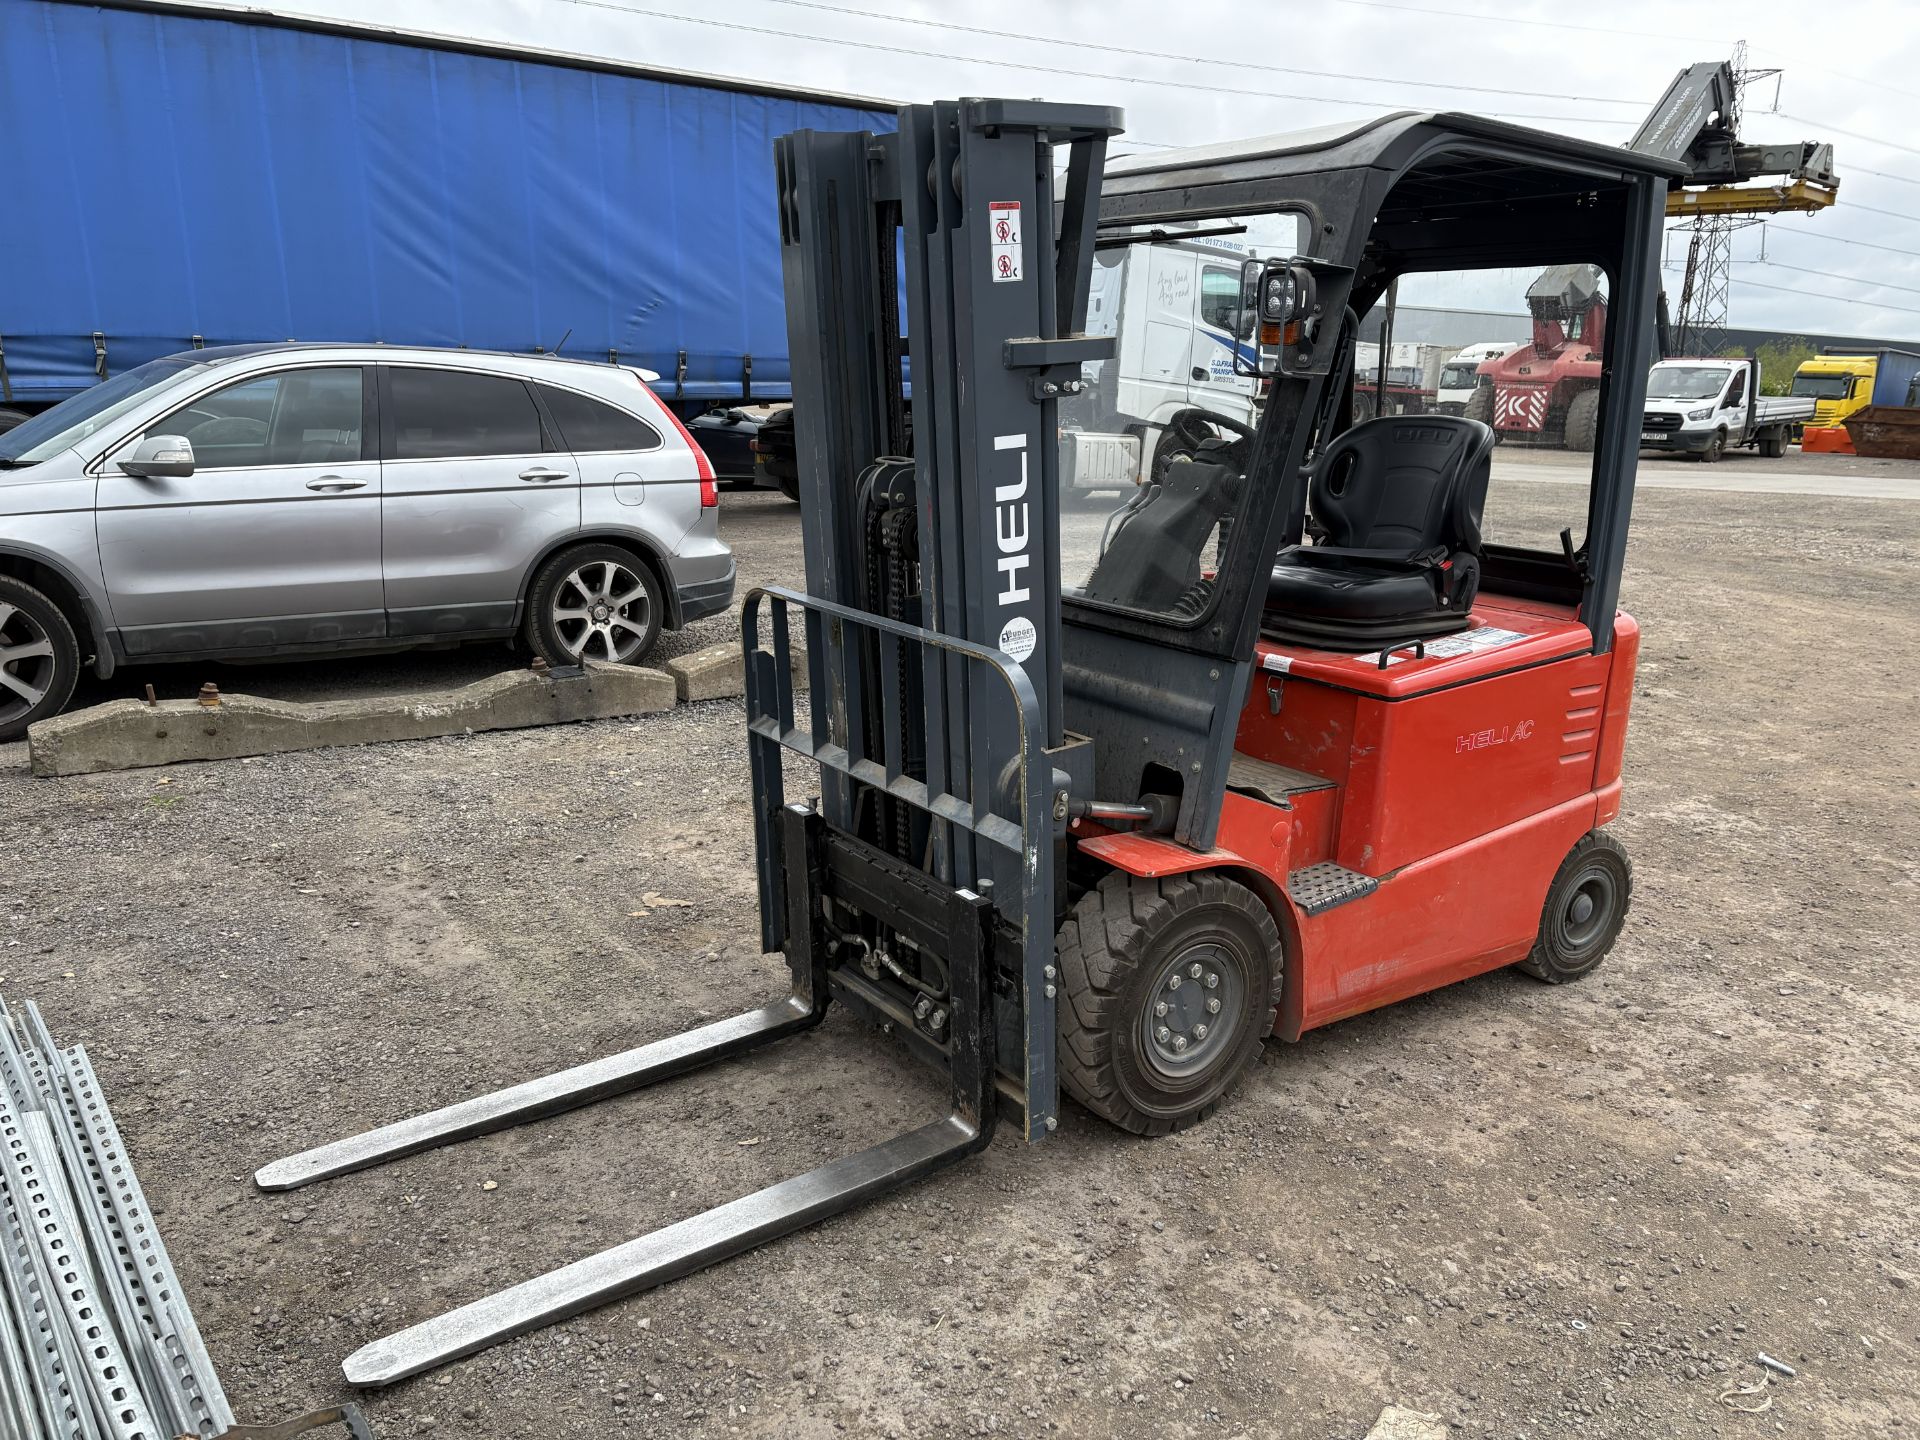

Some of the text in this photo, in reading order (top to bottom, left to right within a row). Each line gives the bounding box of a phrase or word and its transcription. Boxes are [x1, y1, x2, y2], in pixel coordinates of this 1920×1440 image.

[1158, 270, 1172, 290] Any
[1159, 286, 1173, 306] Any
[1211, 360, 1242, 368] S.D.FRAR
[1214, 376, 1235, 384] BRISTOL
[994, 433, 1030, 606] HELI
[1456, 719, 1534, 753] HELI AC
